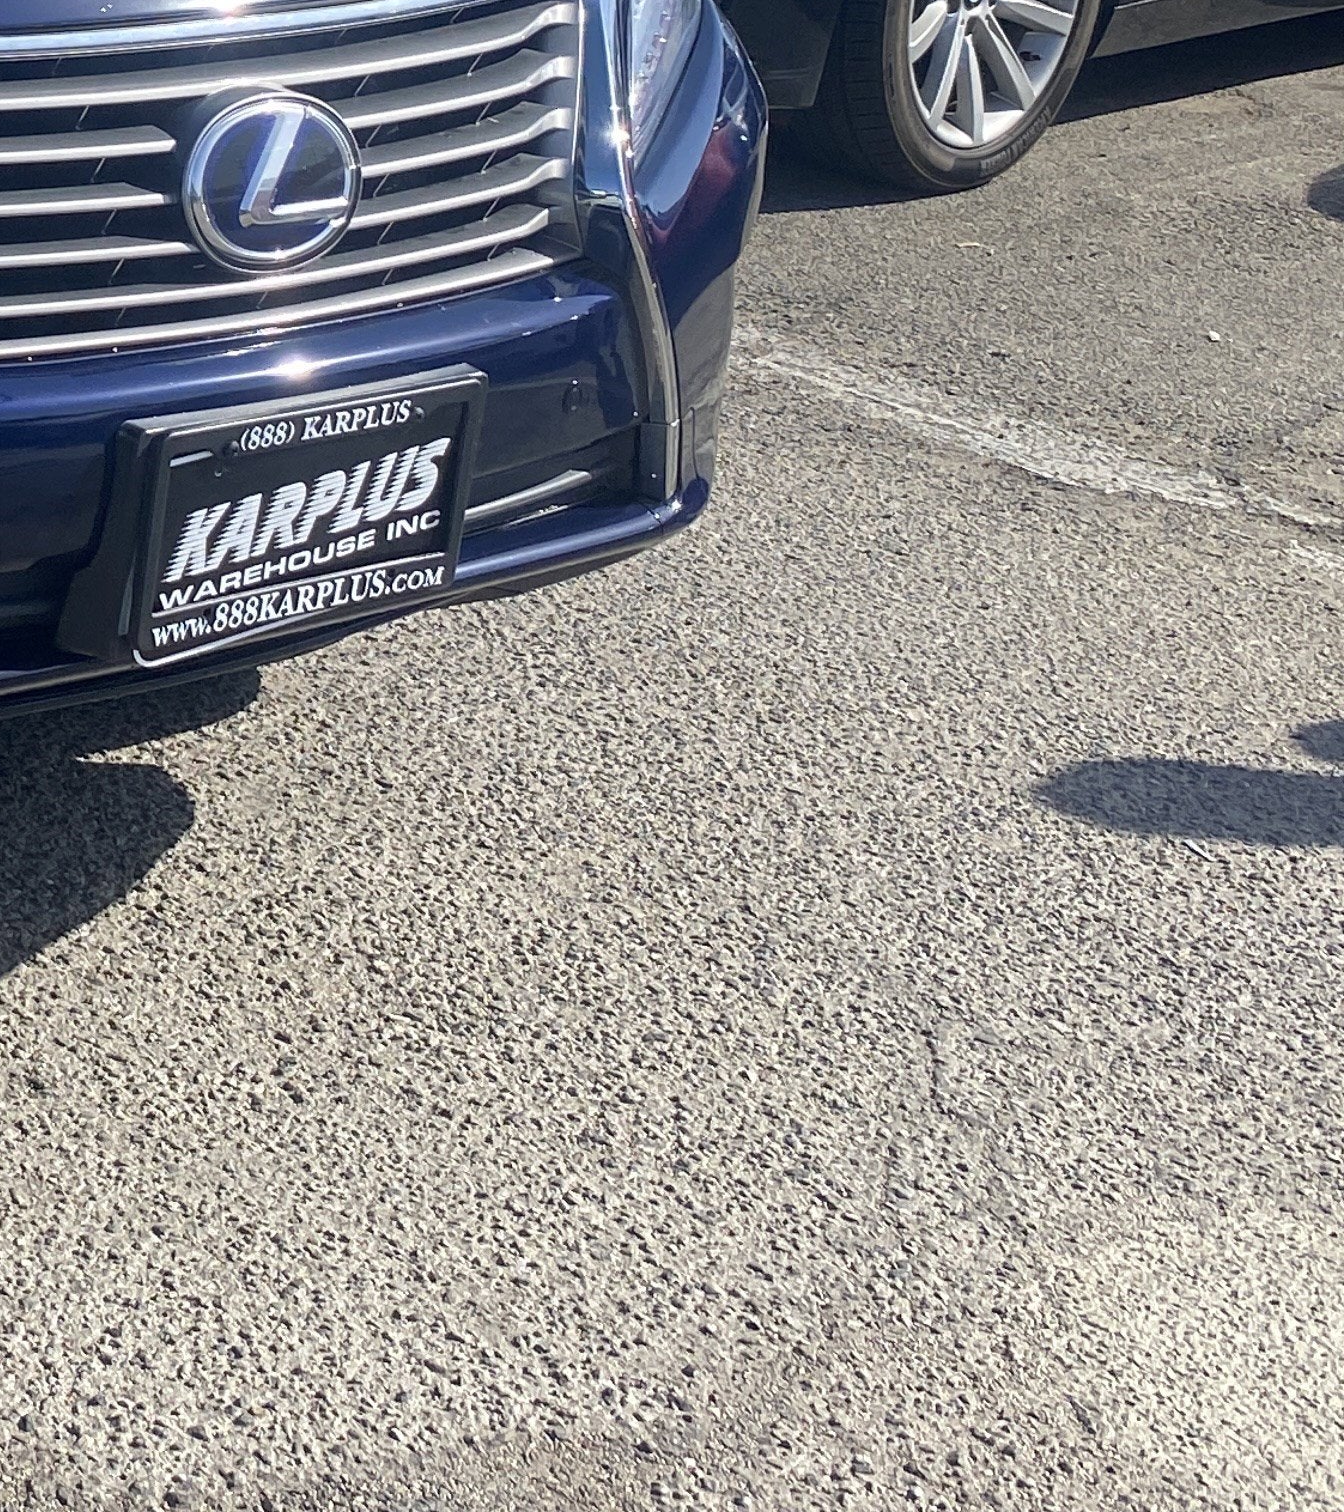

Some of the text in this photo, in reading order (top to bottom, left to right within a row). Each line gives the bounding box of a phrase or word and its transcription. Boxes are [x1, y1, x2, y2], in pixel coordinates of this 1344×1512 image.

[240, 399, 412, 452] (888) KARPLUS
[158, 509, 442, 611] WAREHOUSE INC
[161, 437, 452, 584] KARPLUS
